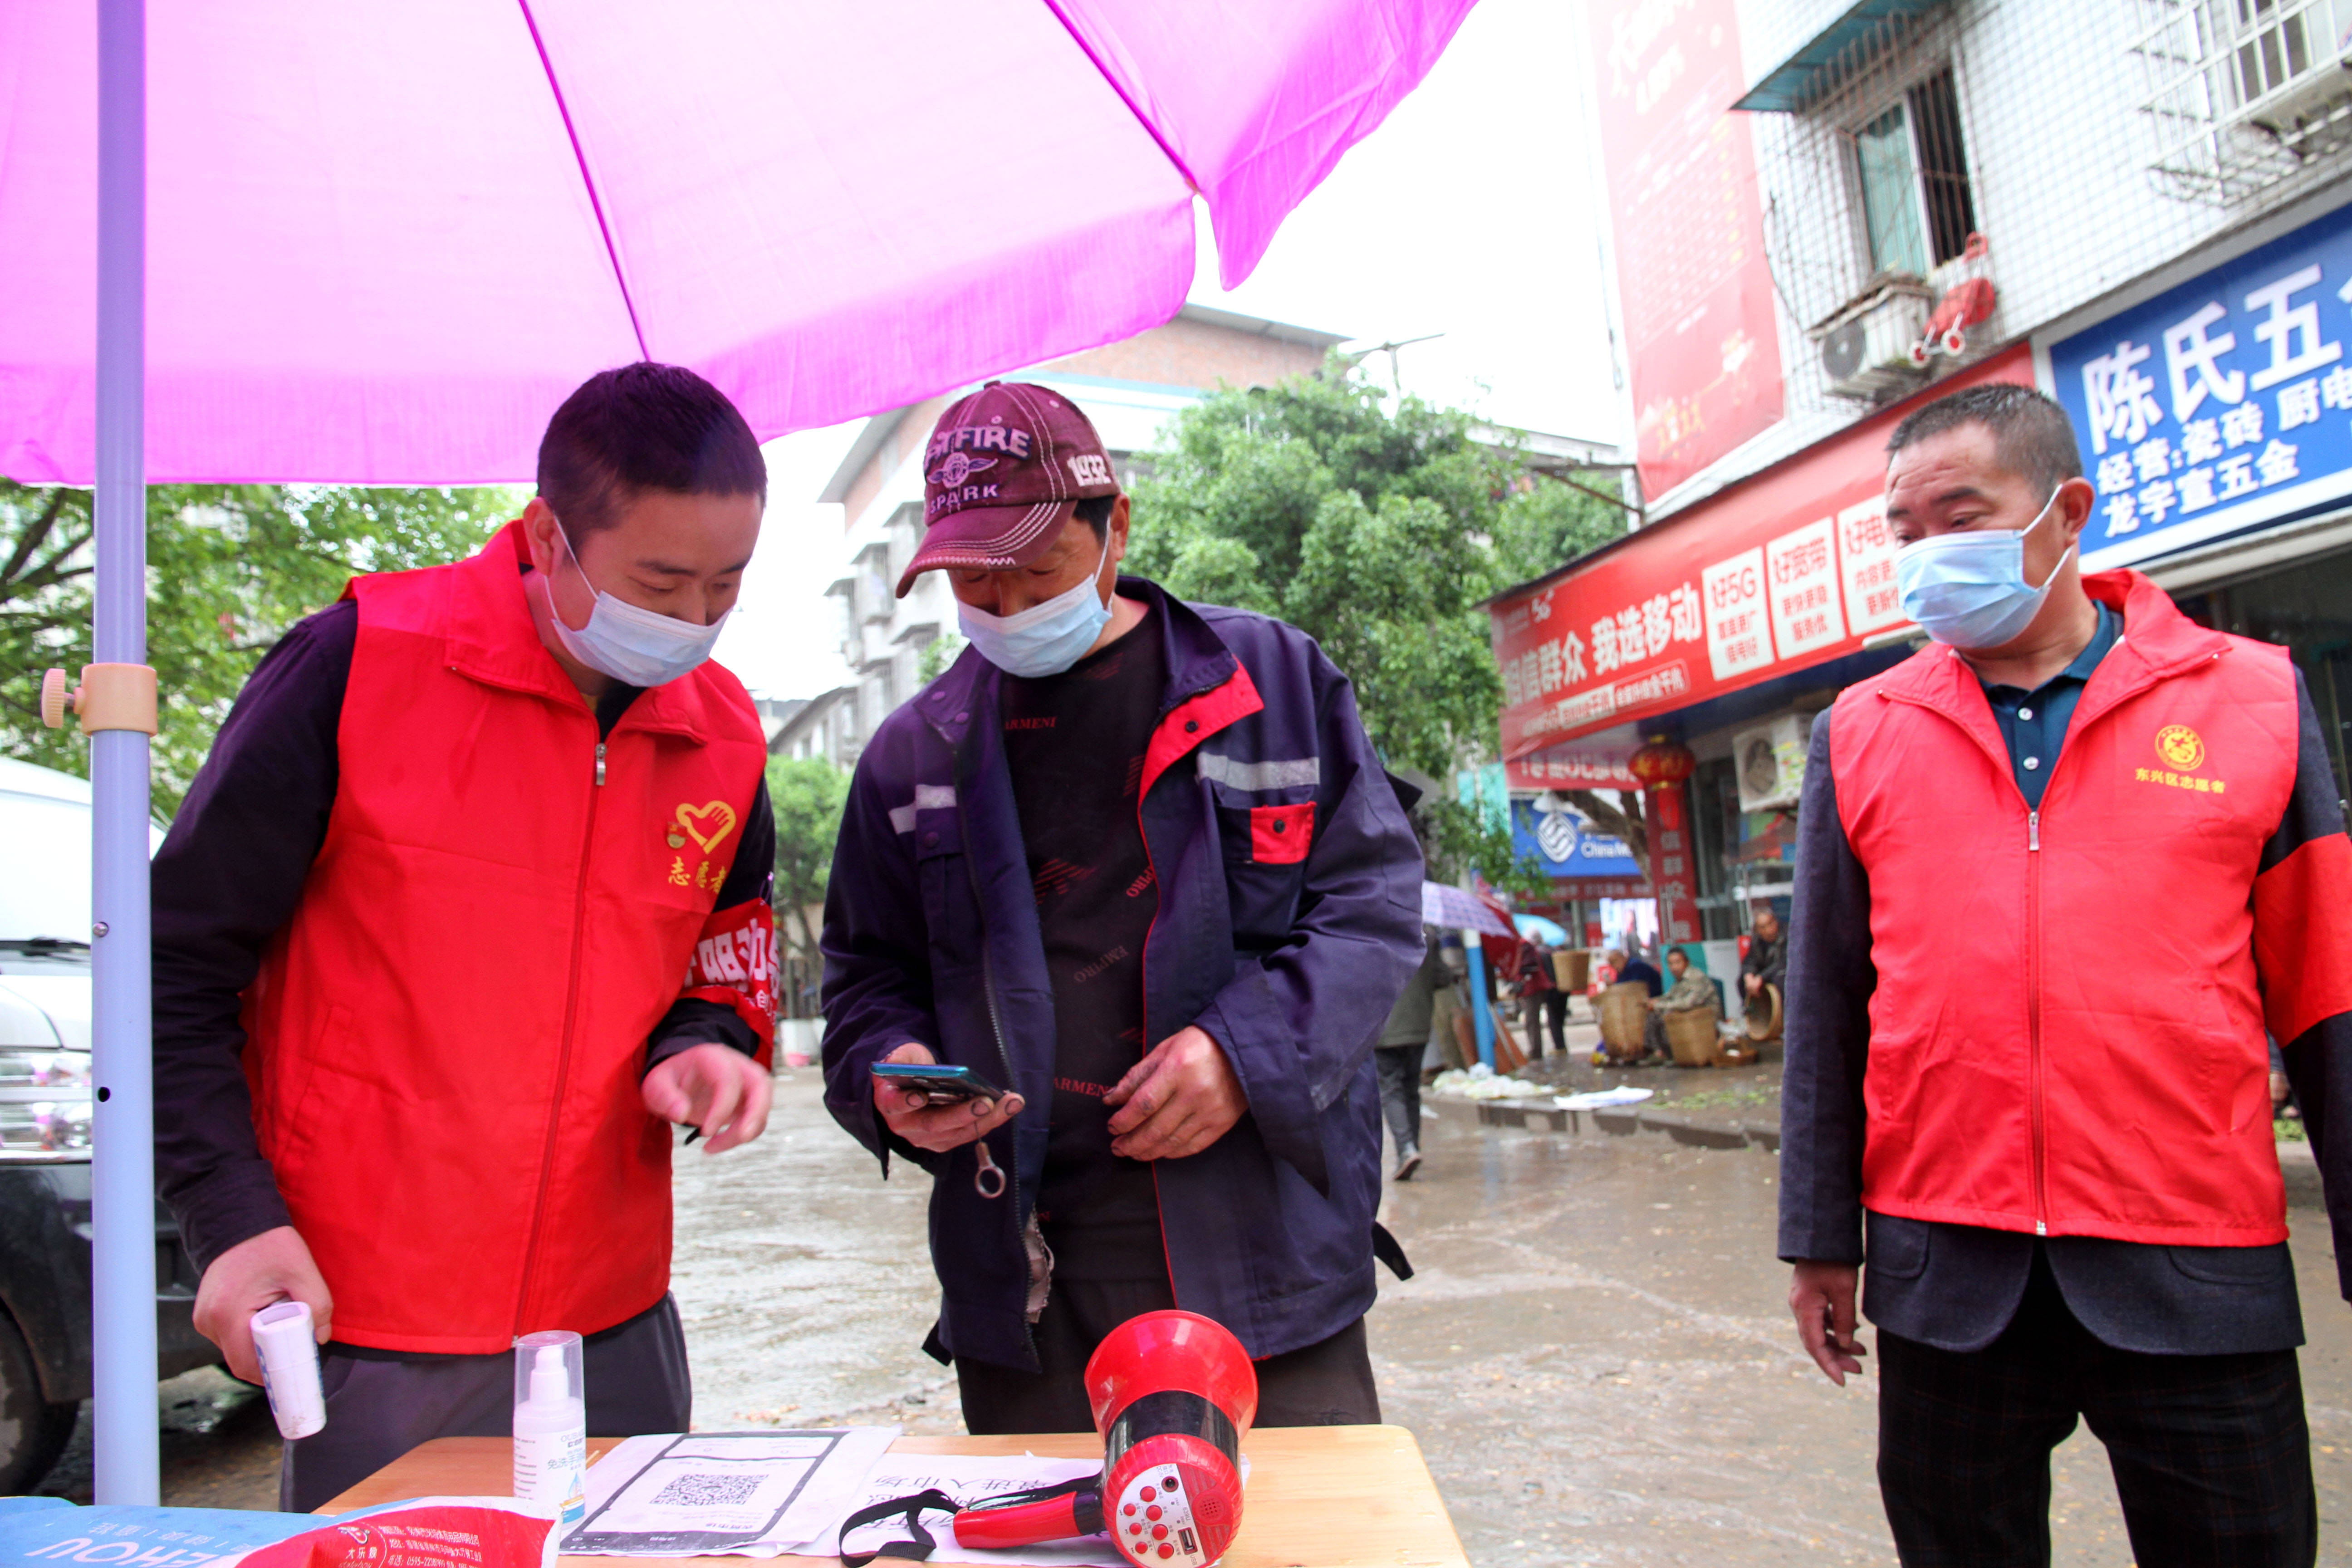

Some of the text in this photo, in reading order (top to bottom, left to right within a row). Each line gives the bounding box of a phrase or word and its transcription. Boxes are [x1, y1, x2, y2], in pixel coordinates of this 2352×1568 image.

[2276, 364, 2352, 431] 厨电
[1067, 454, 1112, 487] 1932
[930, 483, 1000, 514] SPARK
[1845, 514, 1896, 556] 好电
[1772, 536, 1827, 587] 好宽带
[1855, 559, 1898, 590] 内容更
[1710, 567, 1757, 610] 好5G
[1591, 581, 1703, 676] 我选移动
